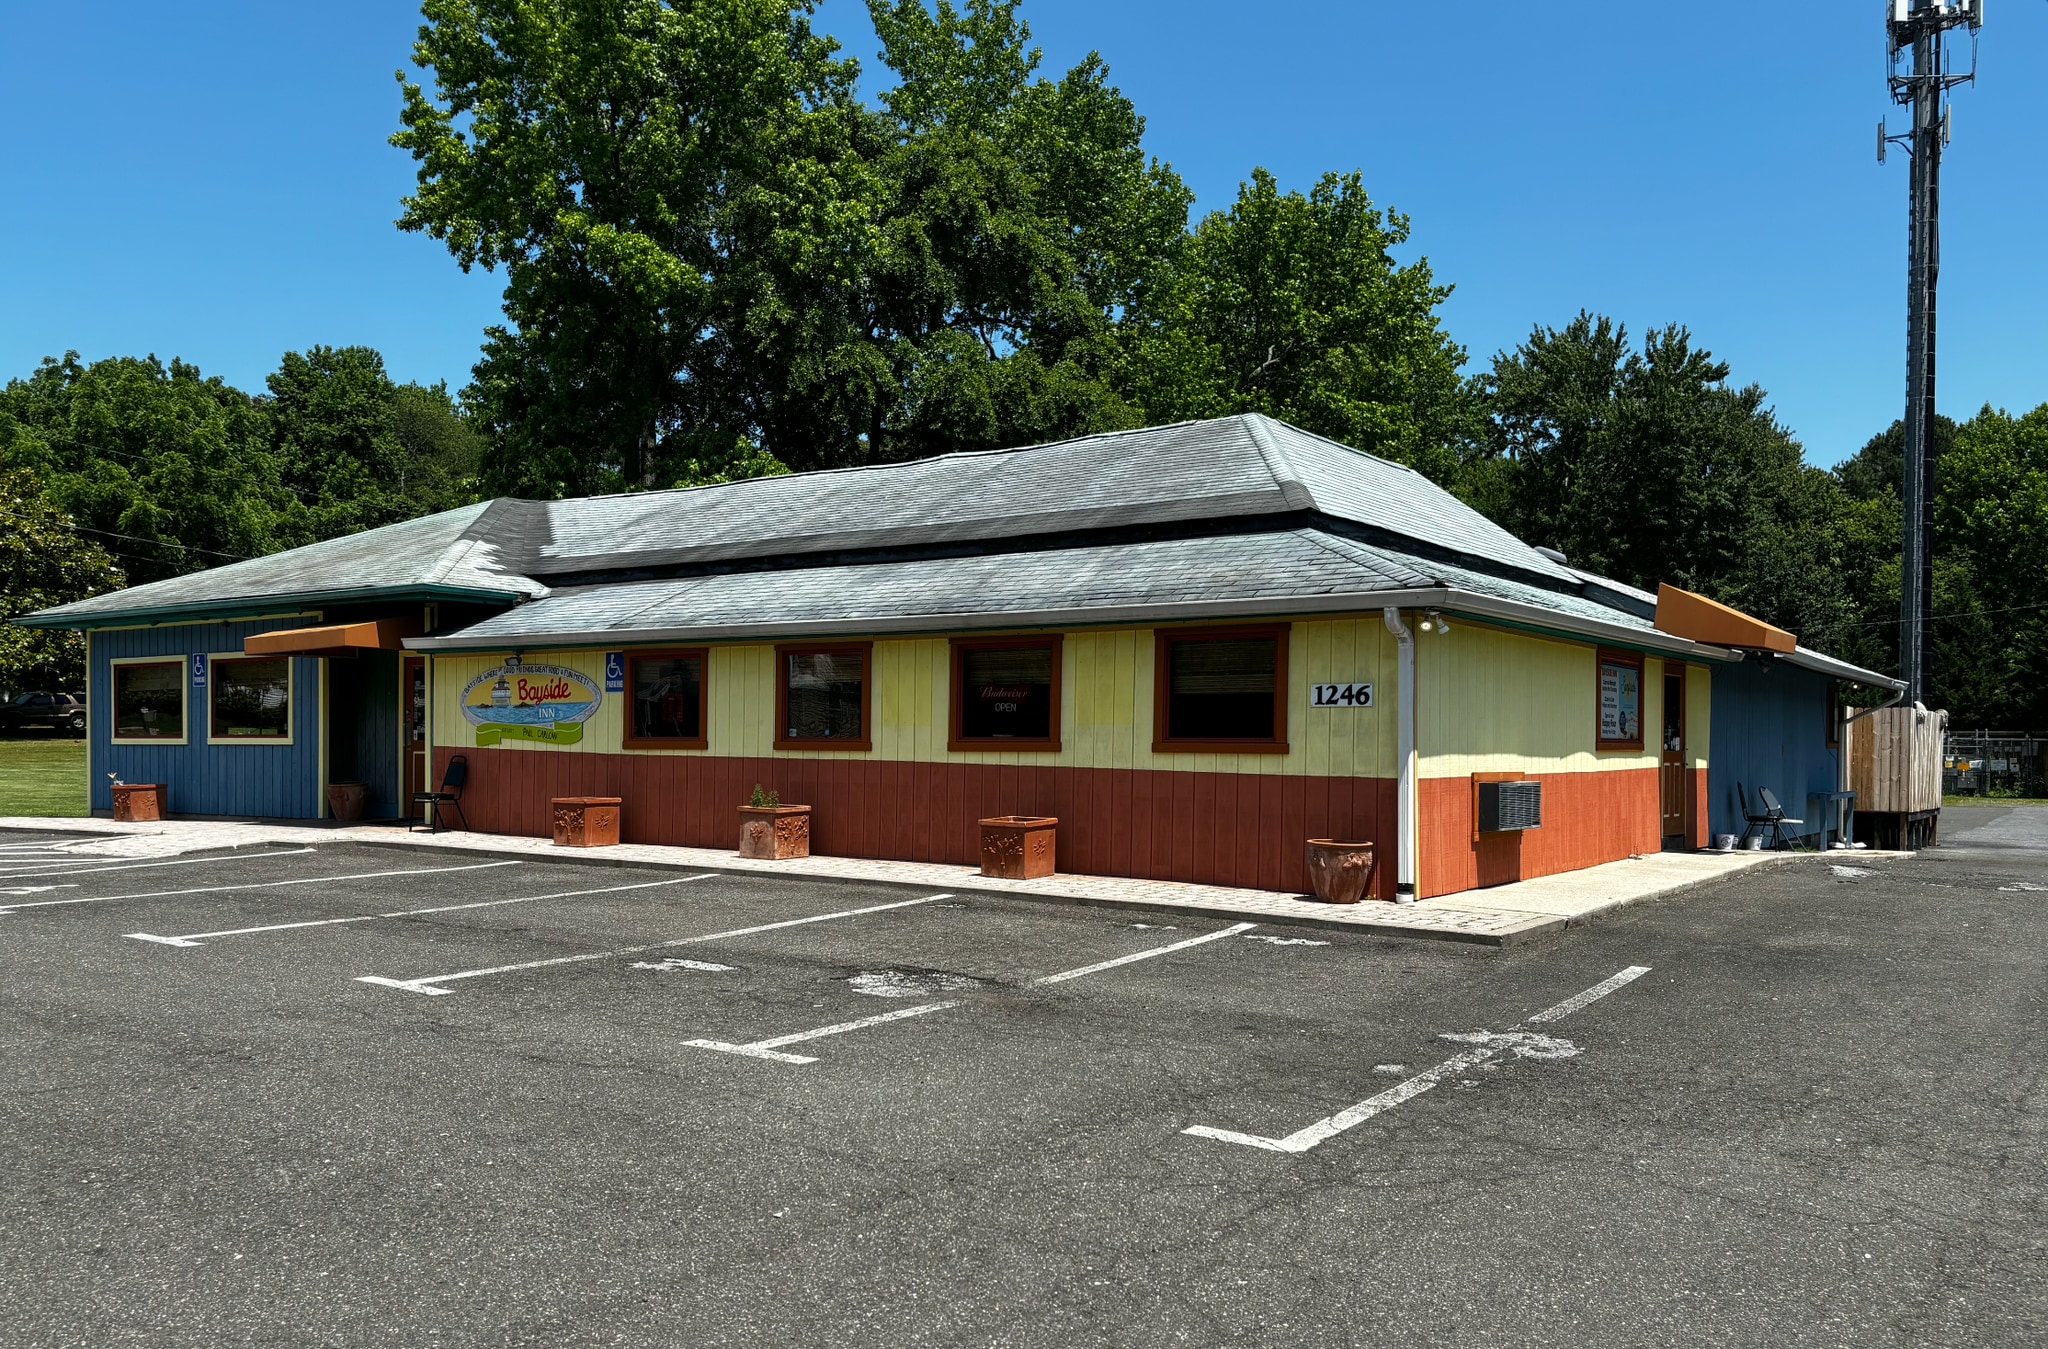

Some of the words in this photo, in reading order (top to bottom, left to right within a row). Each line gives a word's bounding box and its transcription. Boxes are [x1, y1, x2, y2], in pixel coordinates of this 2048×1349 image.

[464, 675, 483, 694] BAYSIDE
[483, 669, 498, 680] WHERE
[503, 666, 515, 674] GOOD
[534, 665, 548, 673] GREAT
[548, 666, 560, 675] FOOD
[564, 670, 573, 678] FUN
[606, 680, 624, 688] PARKING
[517, 677, 571, 706] Bayside
[979, 686, 1028, 698] Budweiser
[1314, 684, 1370, 705] 1246
[538, 707, 555, 719] INN
[994, 702, 1017, 712] OPEN
